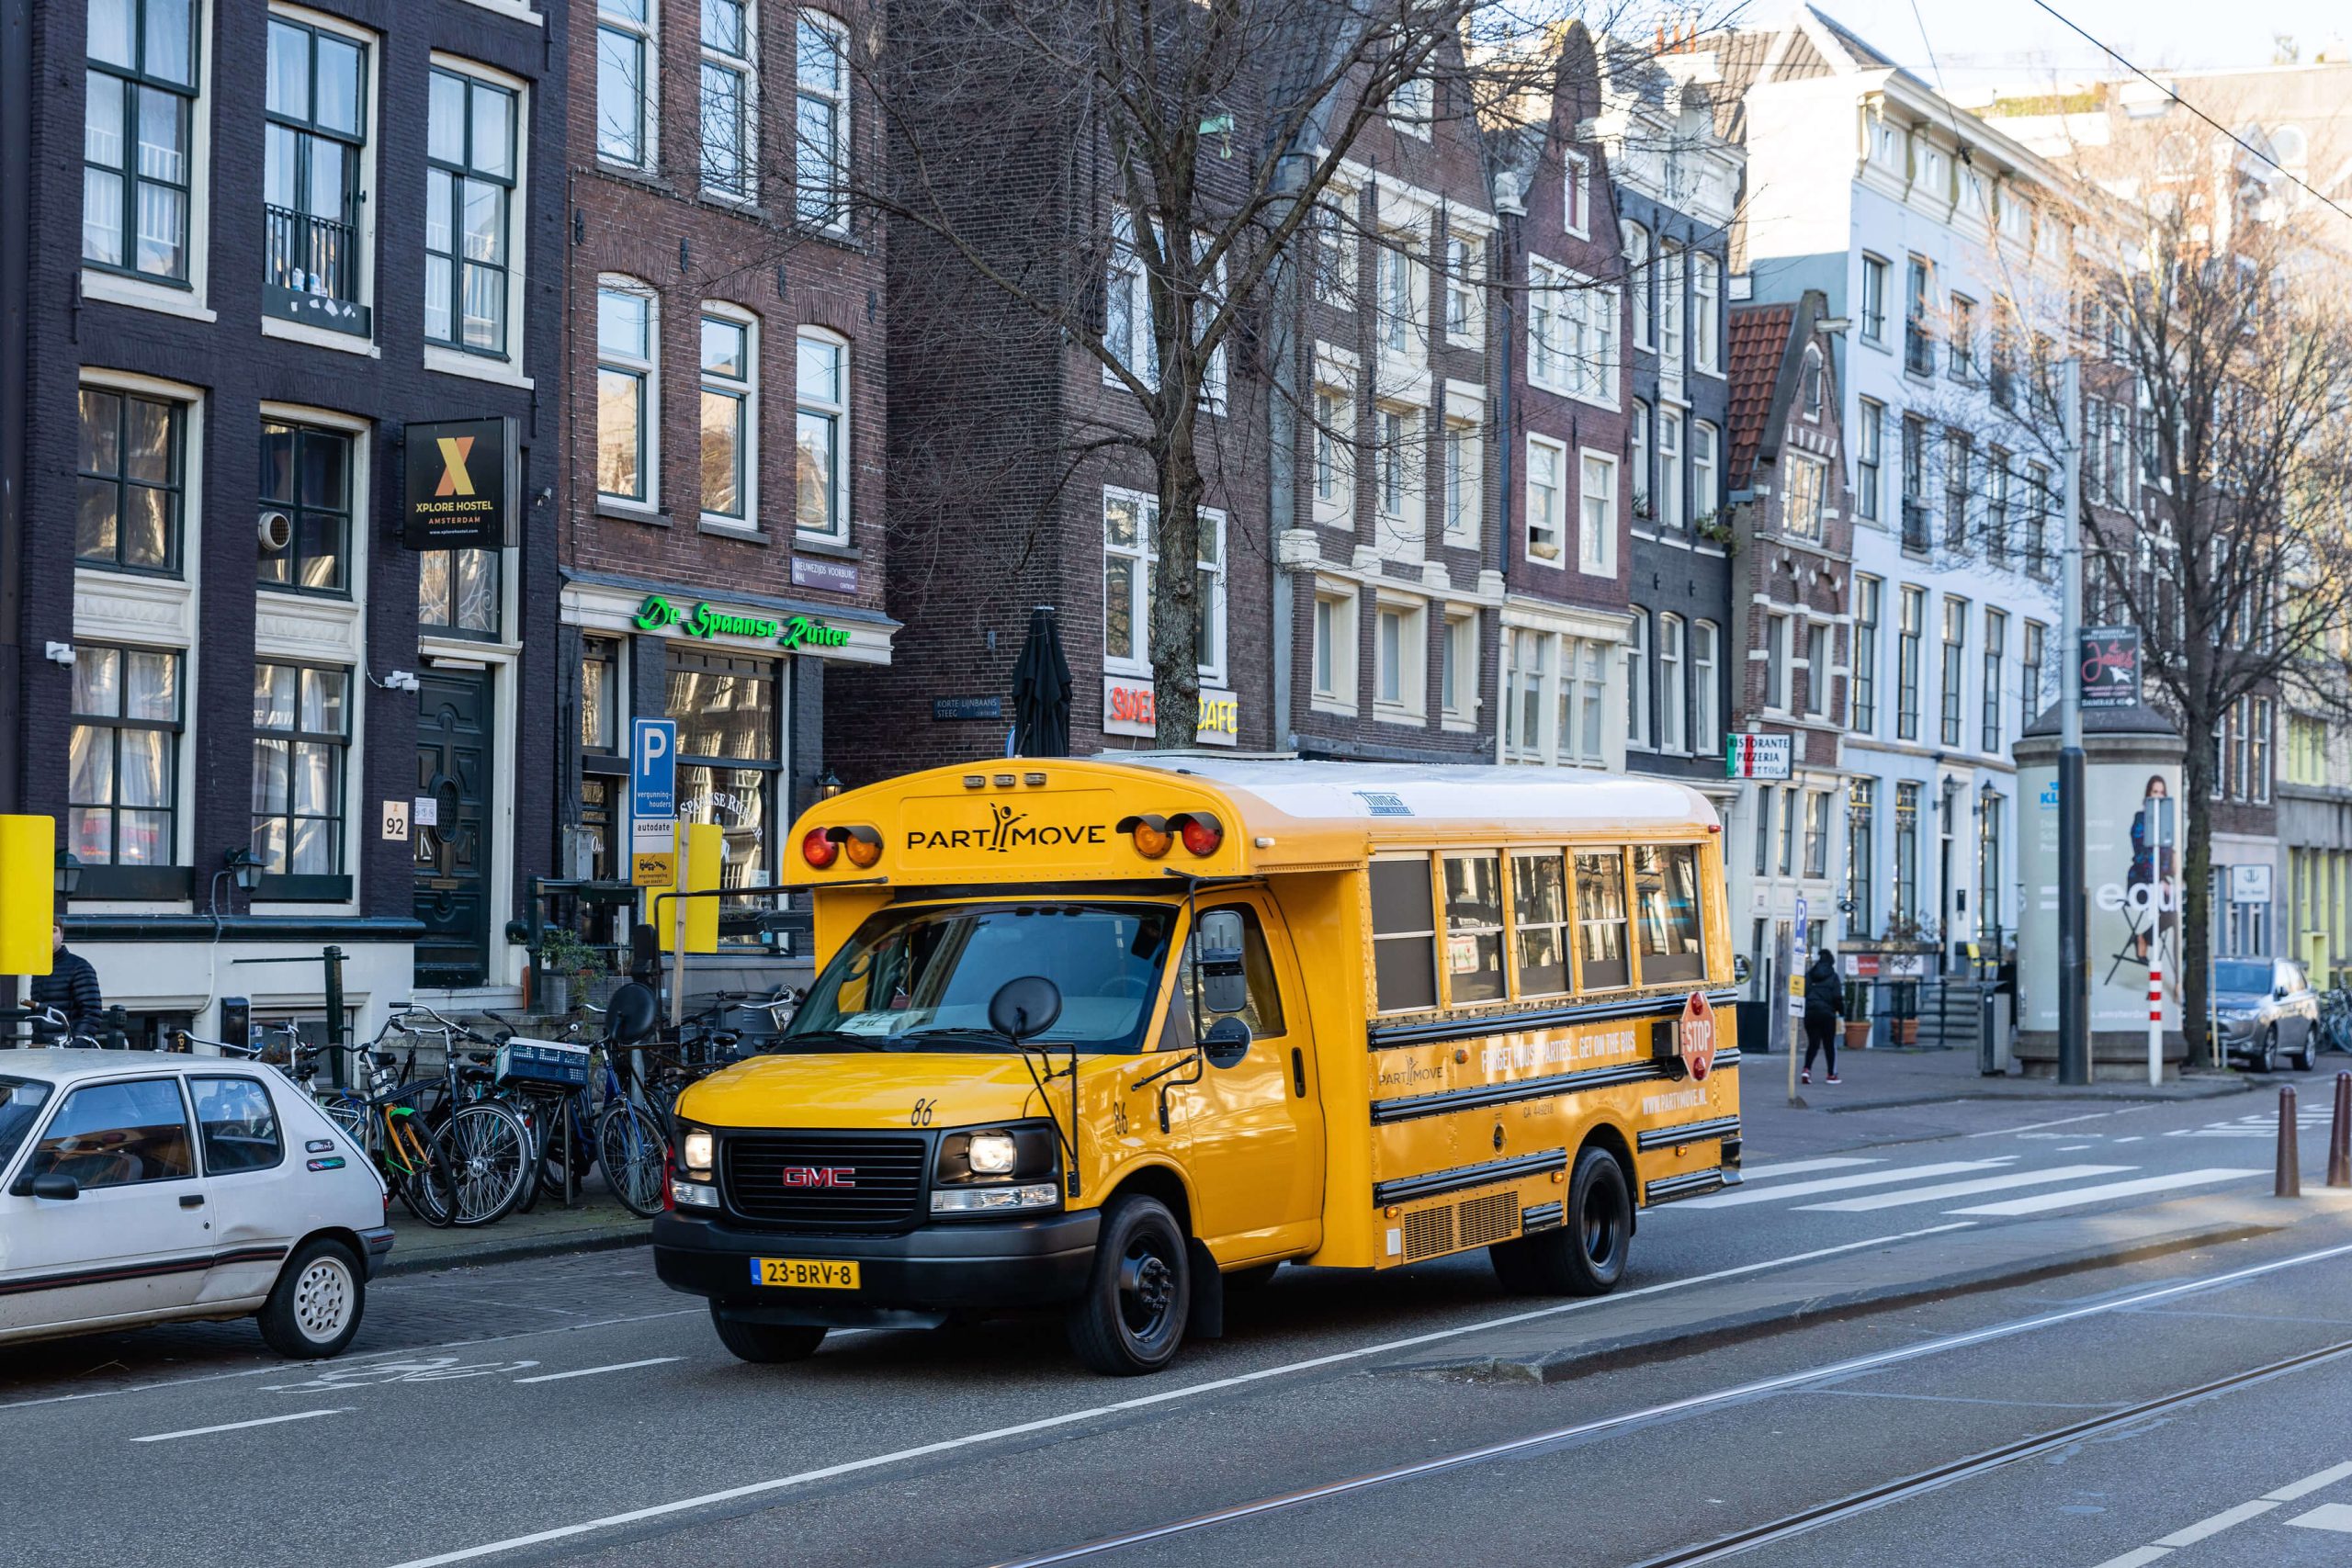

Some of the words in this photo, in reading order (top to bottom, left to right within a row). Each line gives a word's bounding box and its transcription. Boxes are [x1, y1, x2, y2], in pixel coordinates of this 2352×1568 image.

[415, 502, 455, 513] XPLORE
[456, 501, 493, 511] HOSTEL
[428, 516, 481, 525] AMSTERDAM
[795, 571, 806, 582] WAL
[828, 567, 855, 580] VOORBURG
[632, 595, 681, 630] De
[682, 602, 778, 638] Spaanse
[778, 616, 852, 650] Ruiter
[937, 699, 960, 708] KORTE
[961, 698, 997, 709] LIJNBAANS
[937, 709, 957, 717] STEEG
[1728, 738, 1789, 748] RISTORANTE
[644, 728, 667, 775] P
[1736, 752, 1780, 762] PIZZERIA
[637, 791, 673, 799] vergunning-
[2039, 792, 2059, 804] KL
[649, 800, 672, 808] houders
[386, 818, 404, 835] 92
[637, 823, 670, 831] autodate
[1686, 1021, 1711, 1053] STOP
[1514, 1041, 1541, 1070] HOUS
[1579, 1035, 1593, 1059] GET
[1594, 1033, 1605, 1056] ON
[1606, 1032, 1620, 1054] THE
[1621, 1030, 1635, 1053] BUS
[1642, 1088, 1707, 1116] WWW.PARTYMOVE.NL
[910, 1098, 937, 1126] 86
[1113, 1101, 1128, 1135] 86
[783, 1167, 855, 1188] GMC
[767, 1262, 853, 1285] 23-BRV-8
